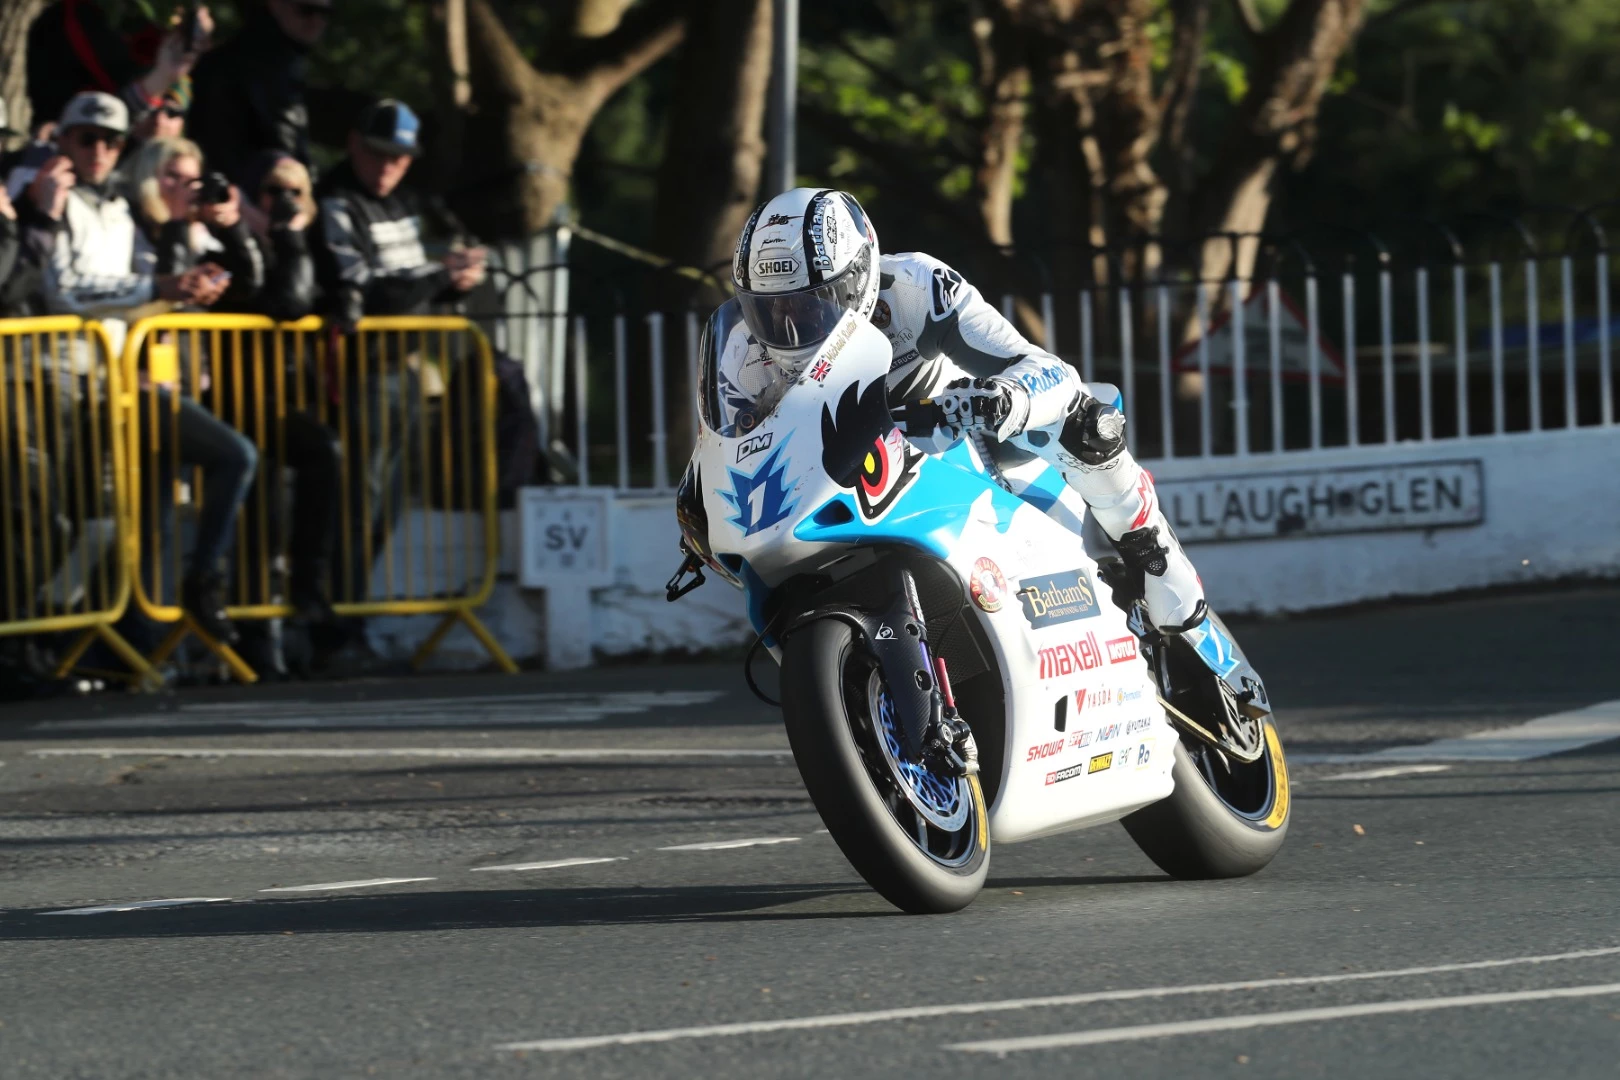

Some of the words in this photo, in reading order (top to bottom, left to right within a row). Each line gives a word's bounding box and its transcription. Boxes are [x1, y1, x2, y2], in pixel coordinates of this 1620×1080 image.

[758, 260, 793, 275] SHOEI
[747, 481, 767, 527] 1
[1162, 486, 1336, 528] LLAUGH
[1358, 476, 1463, 516] GLEN
[544, 523, 589, 552] SV
[1037, 631, 1103, 679] maxell
[1110, 640, 1136, 661] MOTUL
[1026, 738, 1065, 762] SHOWA
[1055, 764, 1082, 780] FACOM
